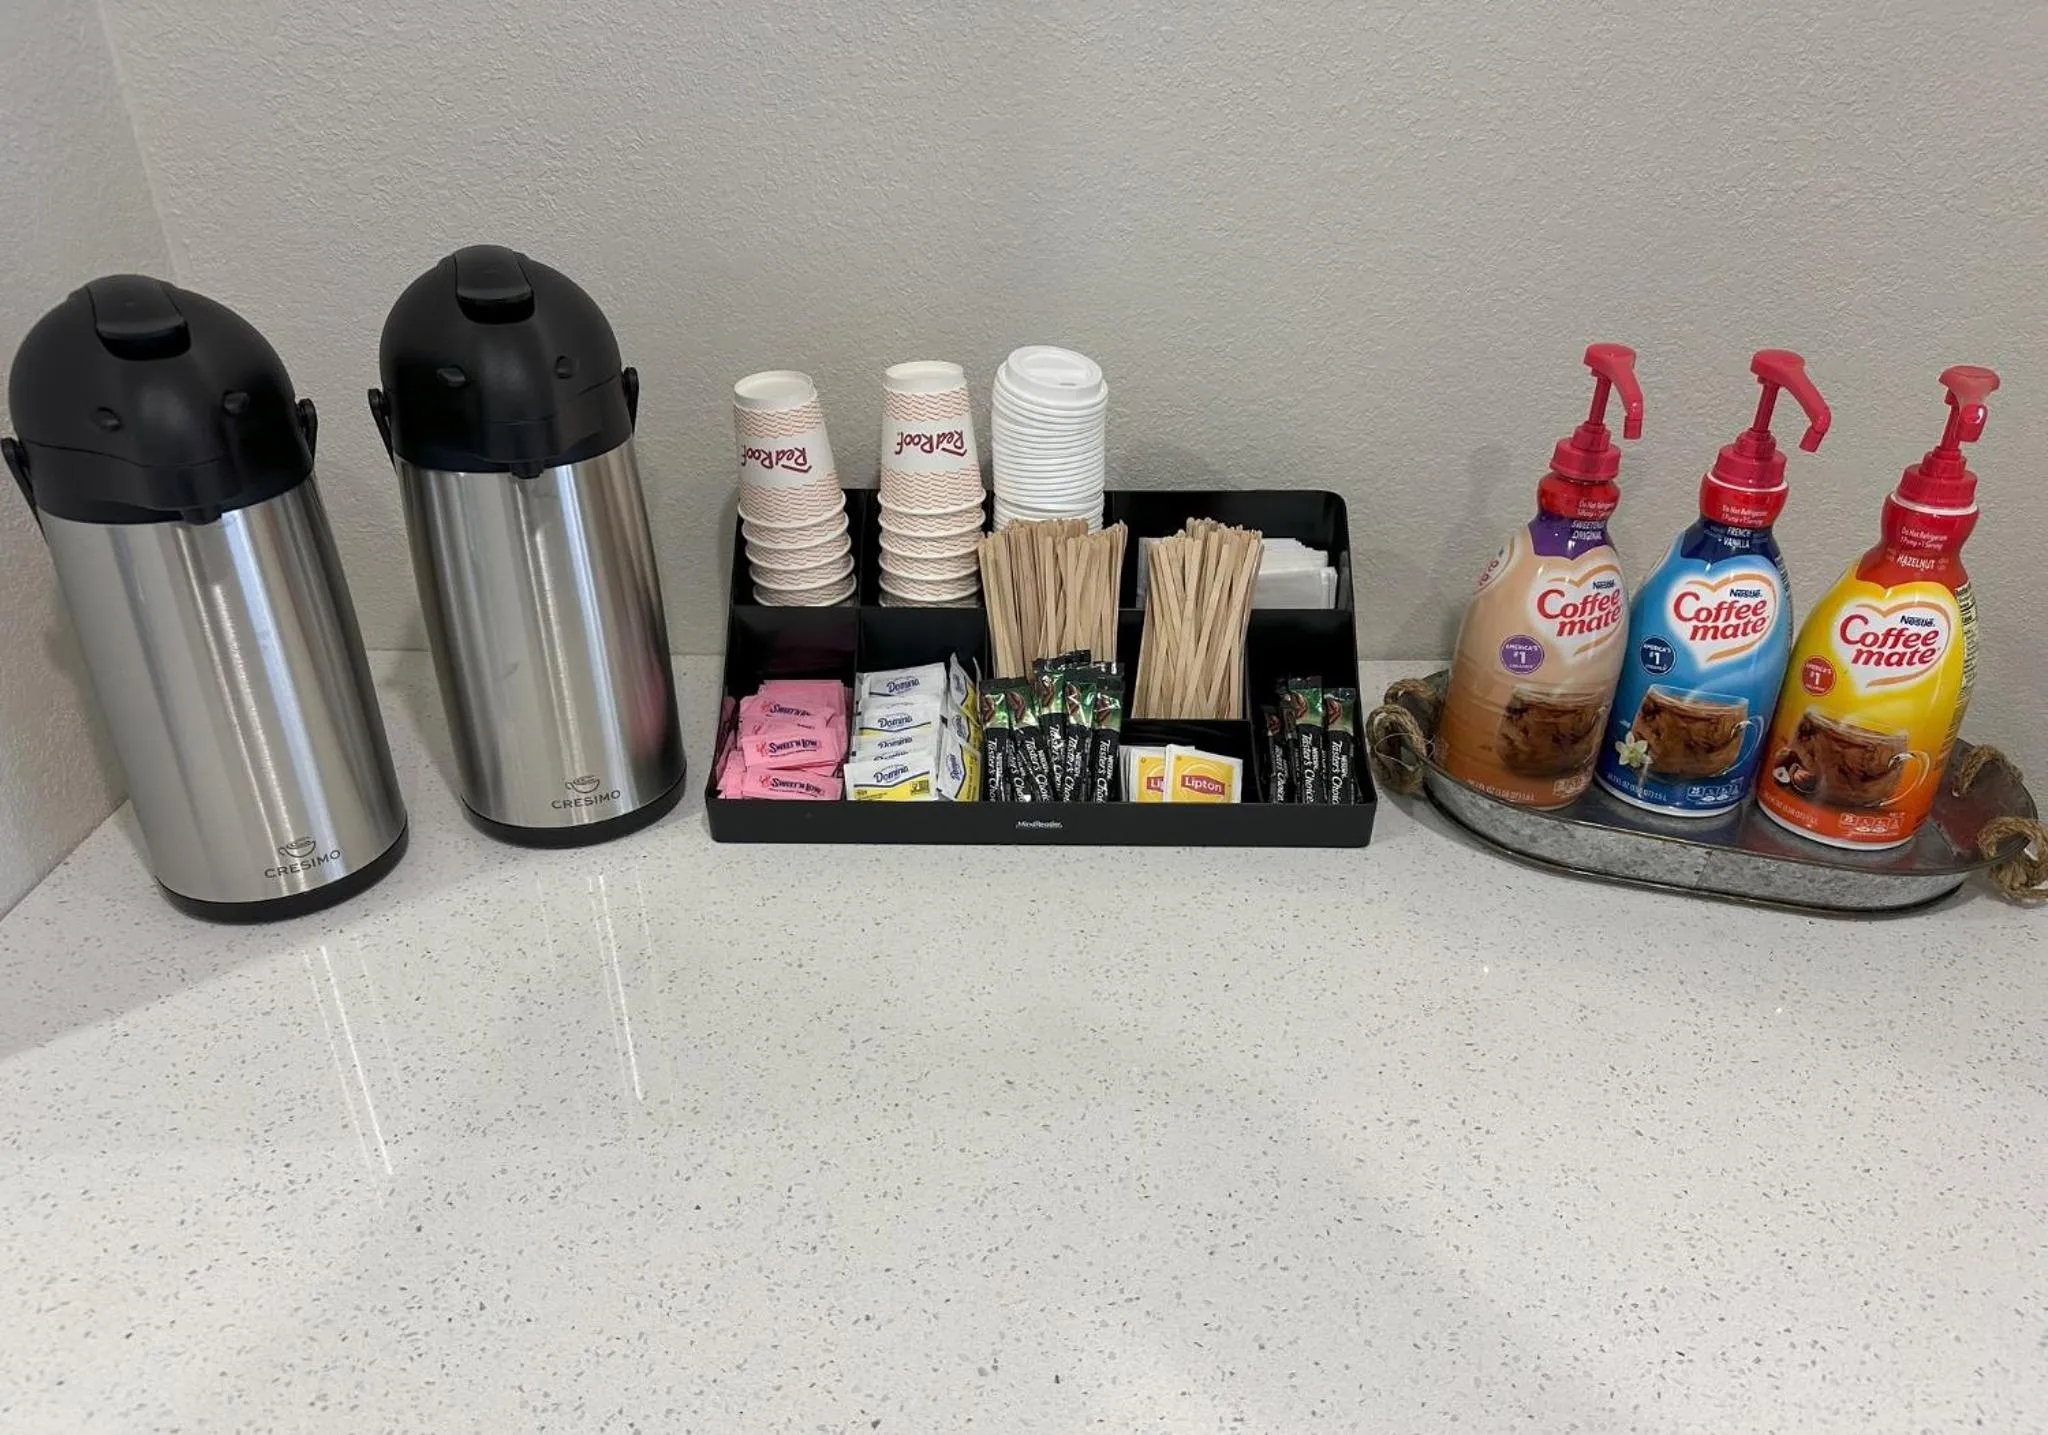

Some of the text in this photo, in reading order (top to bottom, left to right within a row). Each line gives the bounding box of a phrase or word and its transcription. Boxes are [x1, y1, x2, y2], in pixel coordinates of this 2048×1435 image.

[895, 430, 964, 455] Red Roof
[741, 444, 808, 470] Red Roof
[1723, 537, 1750, 548] VANILLA
[1726, 526, 1752, 537] FRENCH
[1909, 528, 1920, 537] Not
[1896, 553, 1936, 569] HAZELNUT
[1537, 588, 1621, 620] Coffee
[1673, 590, 1767, 623] Coffee
[1556, 606, 1621, 637] mate
[1689, 616, 1767, 641] mate
[1840, 613, 1939, 649] Coffee
[1851, 647, 1937, 667] mate
[886, 678, 920, 693] Domino
[878, 714, 913, 728] Domino
[1099, 739, 1111, 775] Taster's
[1302, 733, 1316, 803] Taster's Choice
[1331, 740, 1343, 773] Taster's
[873, 765, 909, 783] Domino
[1185, 776, 1222, 793] Lipton
[551, 790, 621, 809] CRESIMO
[264, 849, 341, 878] CRESIMO
